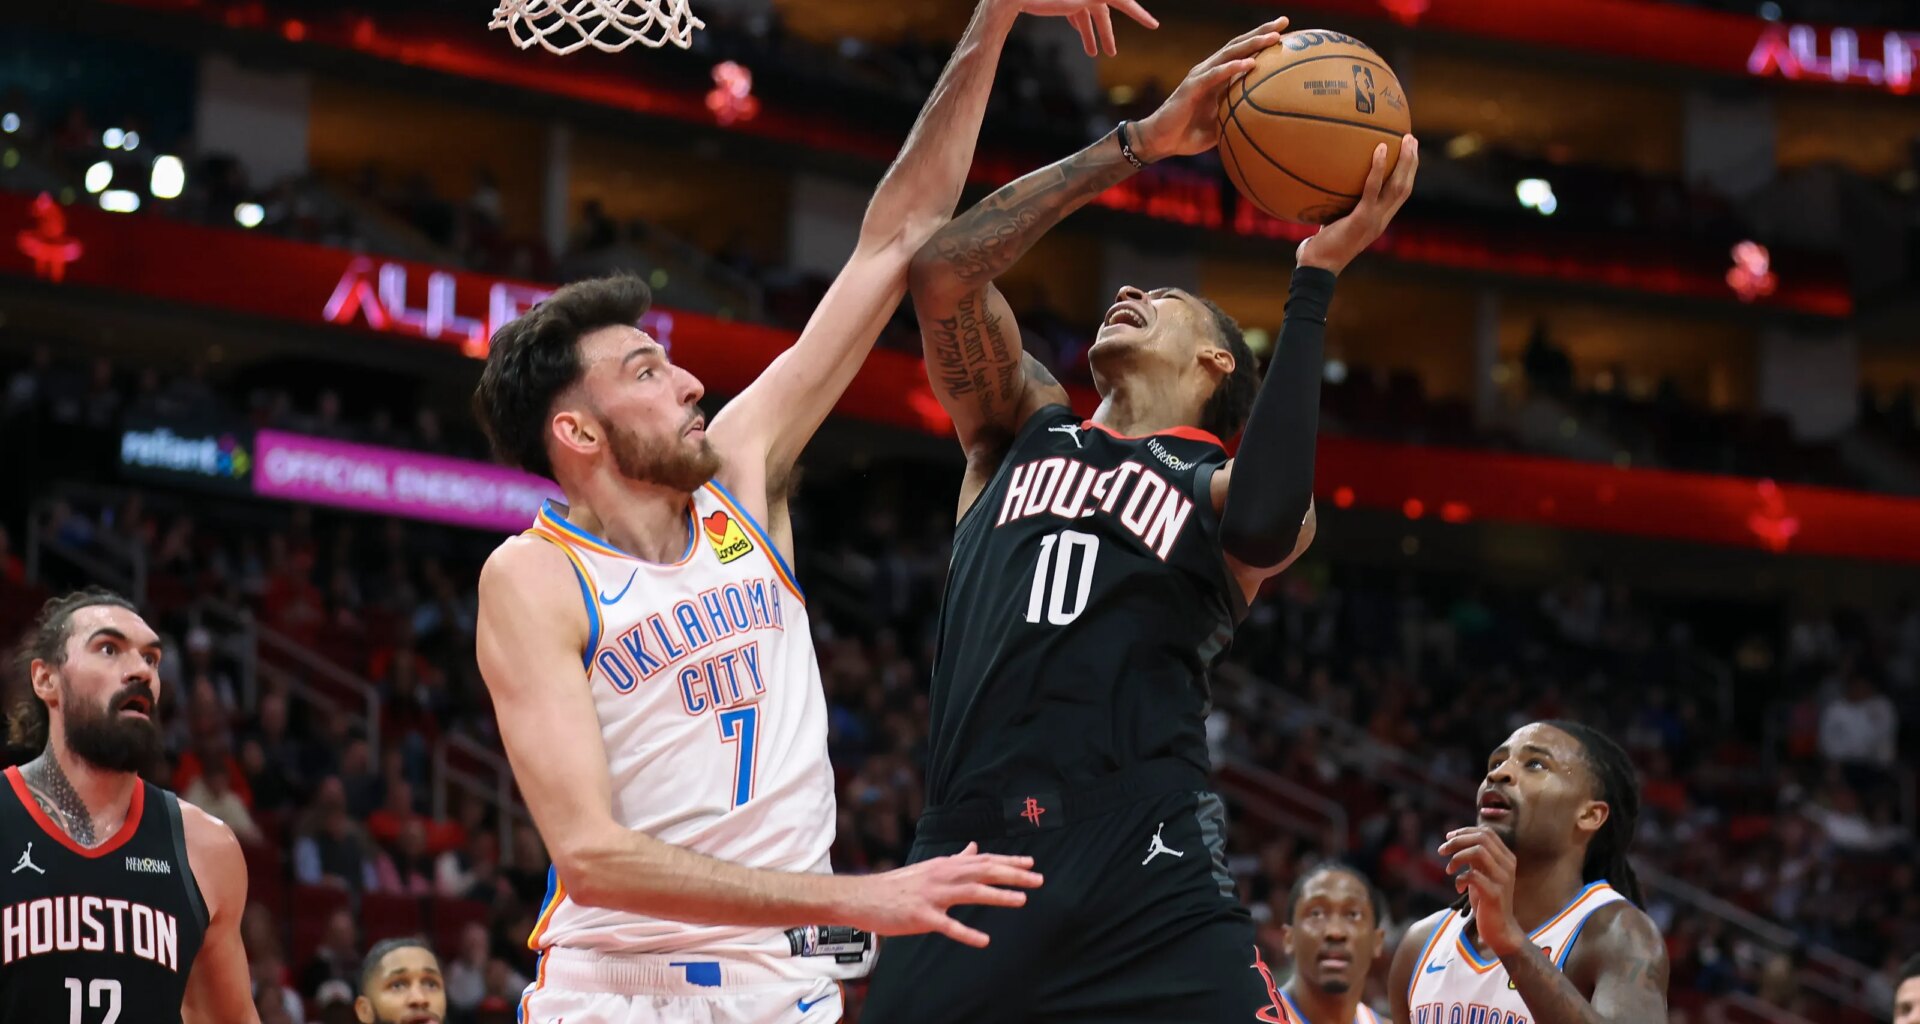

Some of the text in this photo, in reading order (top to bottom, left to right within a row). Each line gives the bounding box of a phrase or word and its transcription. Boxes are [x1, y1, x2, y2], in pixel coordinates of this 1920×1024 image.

[995, 457, 1194, 562] HOUSTON
[1026, 529, 1099, 626] 10
[595, 578, 784, 695] OKLAHOMA
[678, 640, 767, 716] CITY
[715, 702, 760, 811] 7
[2, 894, 179, 974] HOUSTON
[64, 977, 123, 1024] 12
